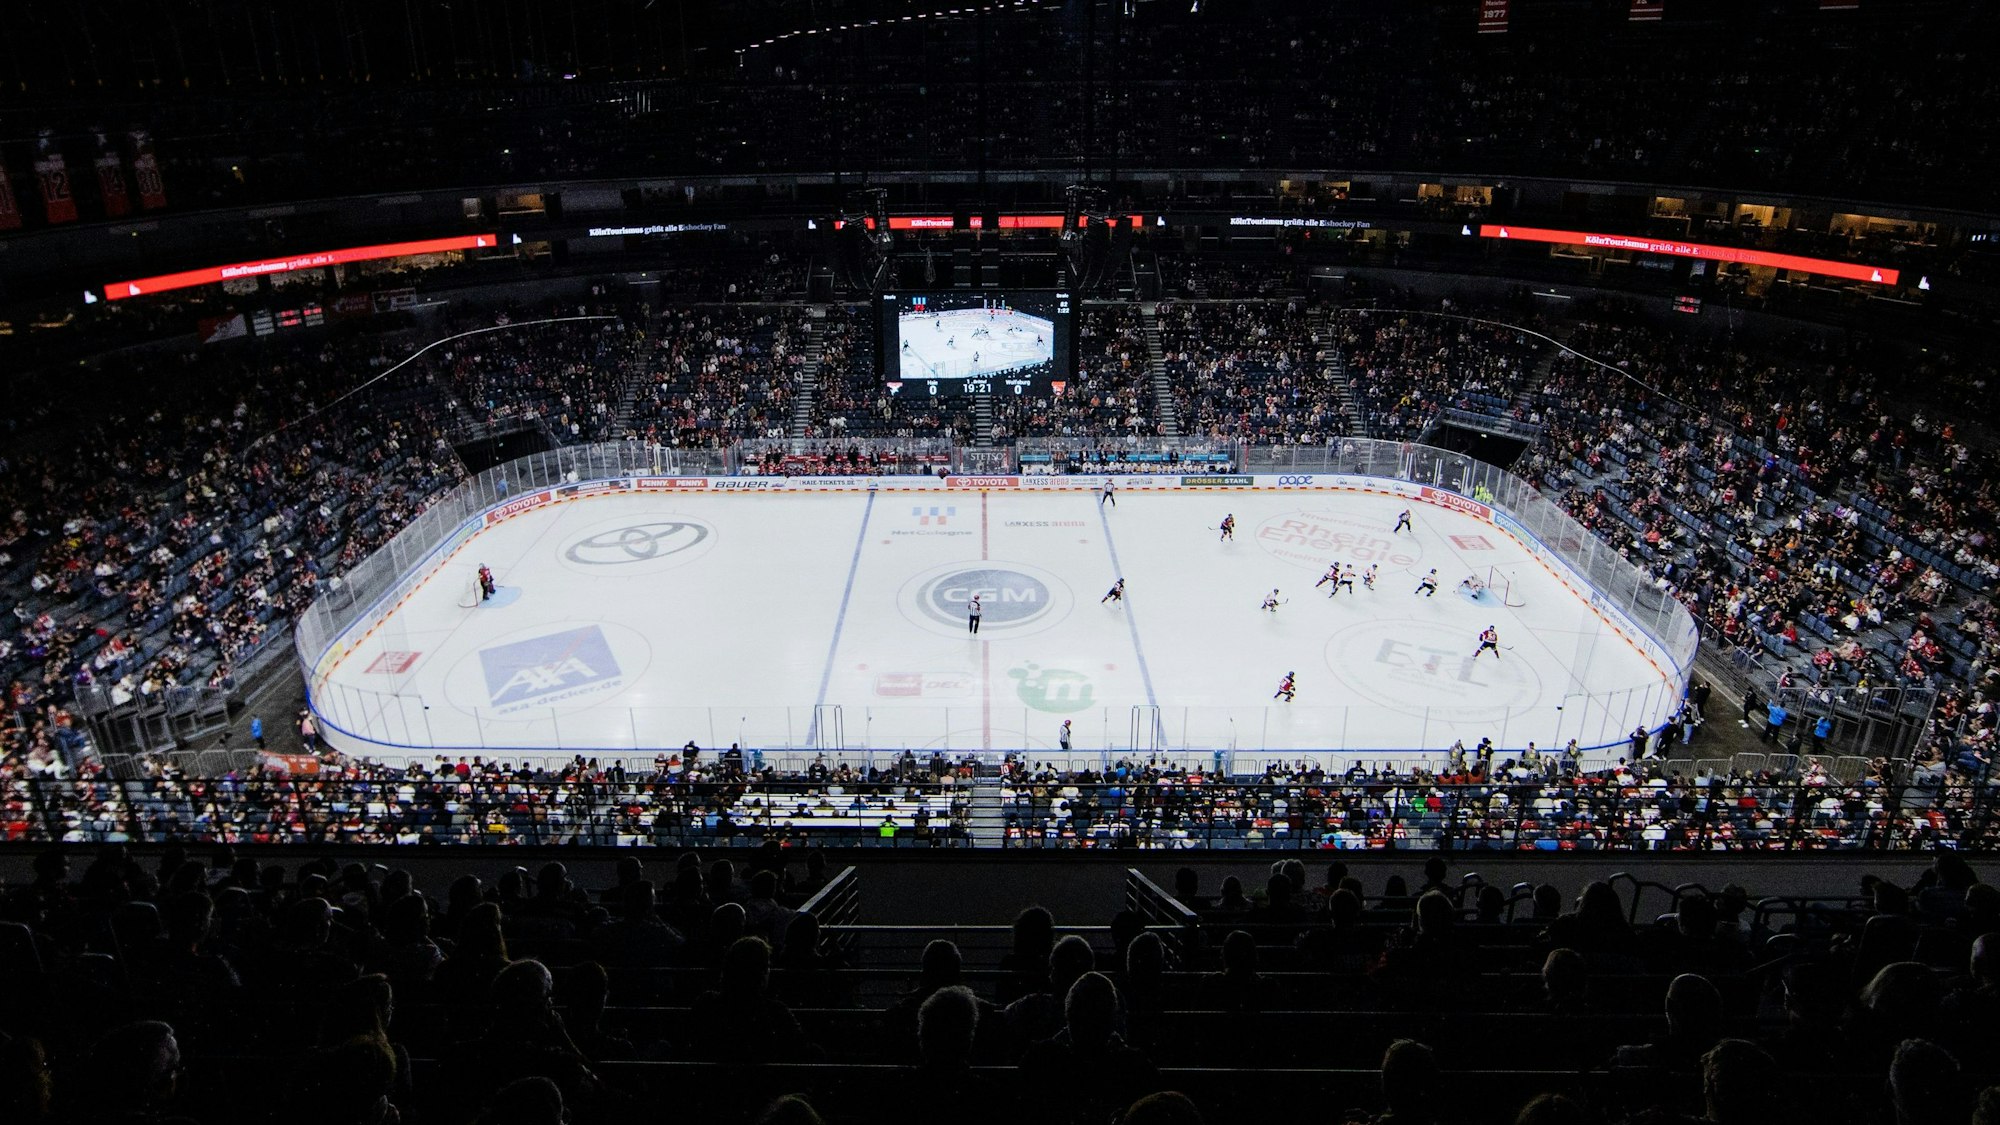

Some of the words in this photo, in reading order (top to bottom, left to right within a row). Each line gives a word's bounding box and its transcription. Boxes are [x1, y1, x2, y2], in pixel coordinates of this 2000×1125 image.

[1483, 9, 1506, 18] 1977
[40, 172, 69, 199] 12
[1230, 218, 1283, 226] KölnTourismus
[1284, 218, 1304, 227] grüßt
[1319, 220, 1355, 229] Eishockey
[589, 226, 643, 236] KölnTourismus
[644, 225, 664, 235] grüßt
[1585, 236, 1648, 249] KölnTourismus
[1650, 242, 1674, 253] grüßt
[1675, 244, 1691, 254] alle
[312, 255, 327, 265] alle
[929, 386, 937, 395] 0
[963, 384, 991, 393] 19:21
[1014, 386, 1022, 395] 0
[970, 452, 1006, 461] STETSO
[641, 479, 669, 487] PENNY.
[676, 479, 704, 487] PENNY.
[973, 478, 1008, 486] TOYOTA
[1049, 477, 1069, 485] arena
[1278, 476, 1313, 486] pape
[507, 496, 541, 513] TOYOTA
[1448, 496, 1481, 514] TOYOTA
[1282, 519, 1392, 550] Rhein
[1259, 527, 1414, 565] Energie
[943, 588, 1036, 602] CGM
[1374, 638, 1488, 688] ETL
[491, 657, 599, 702] AXA
[498, 679, 623, 715] axa-decker.de
